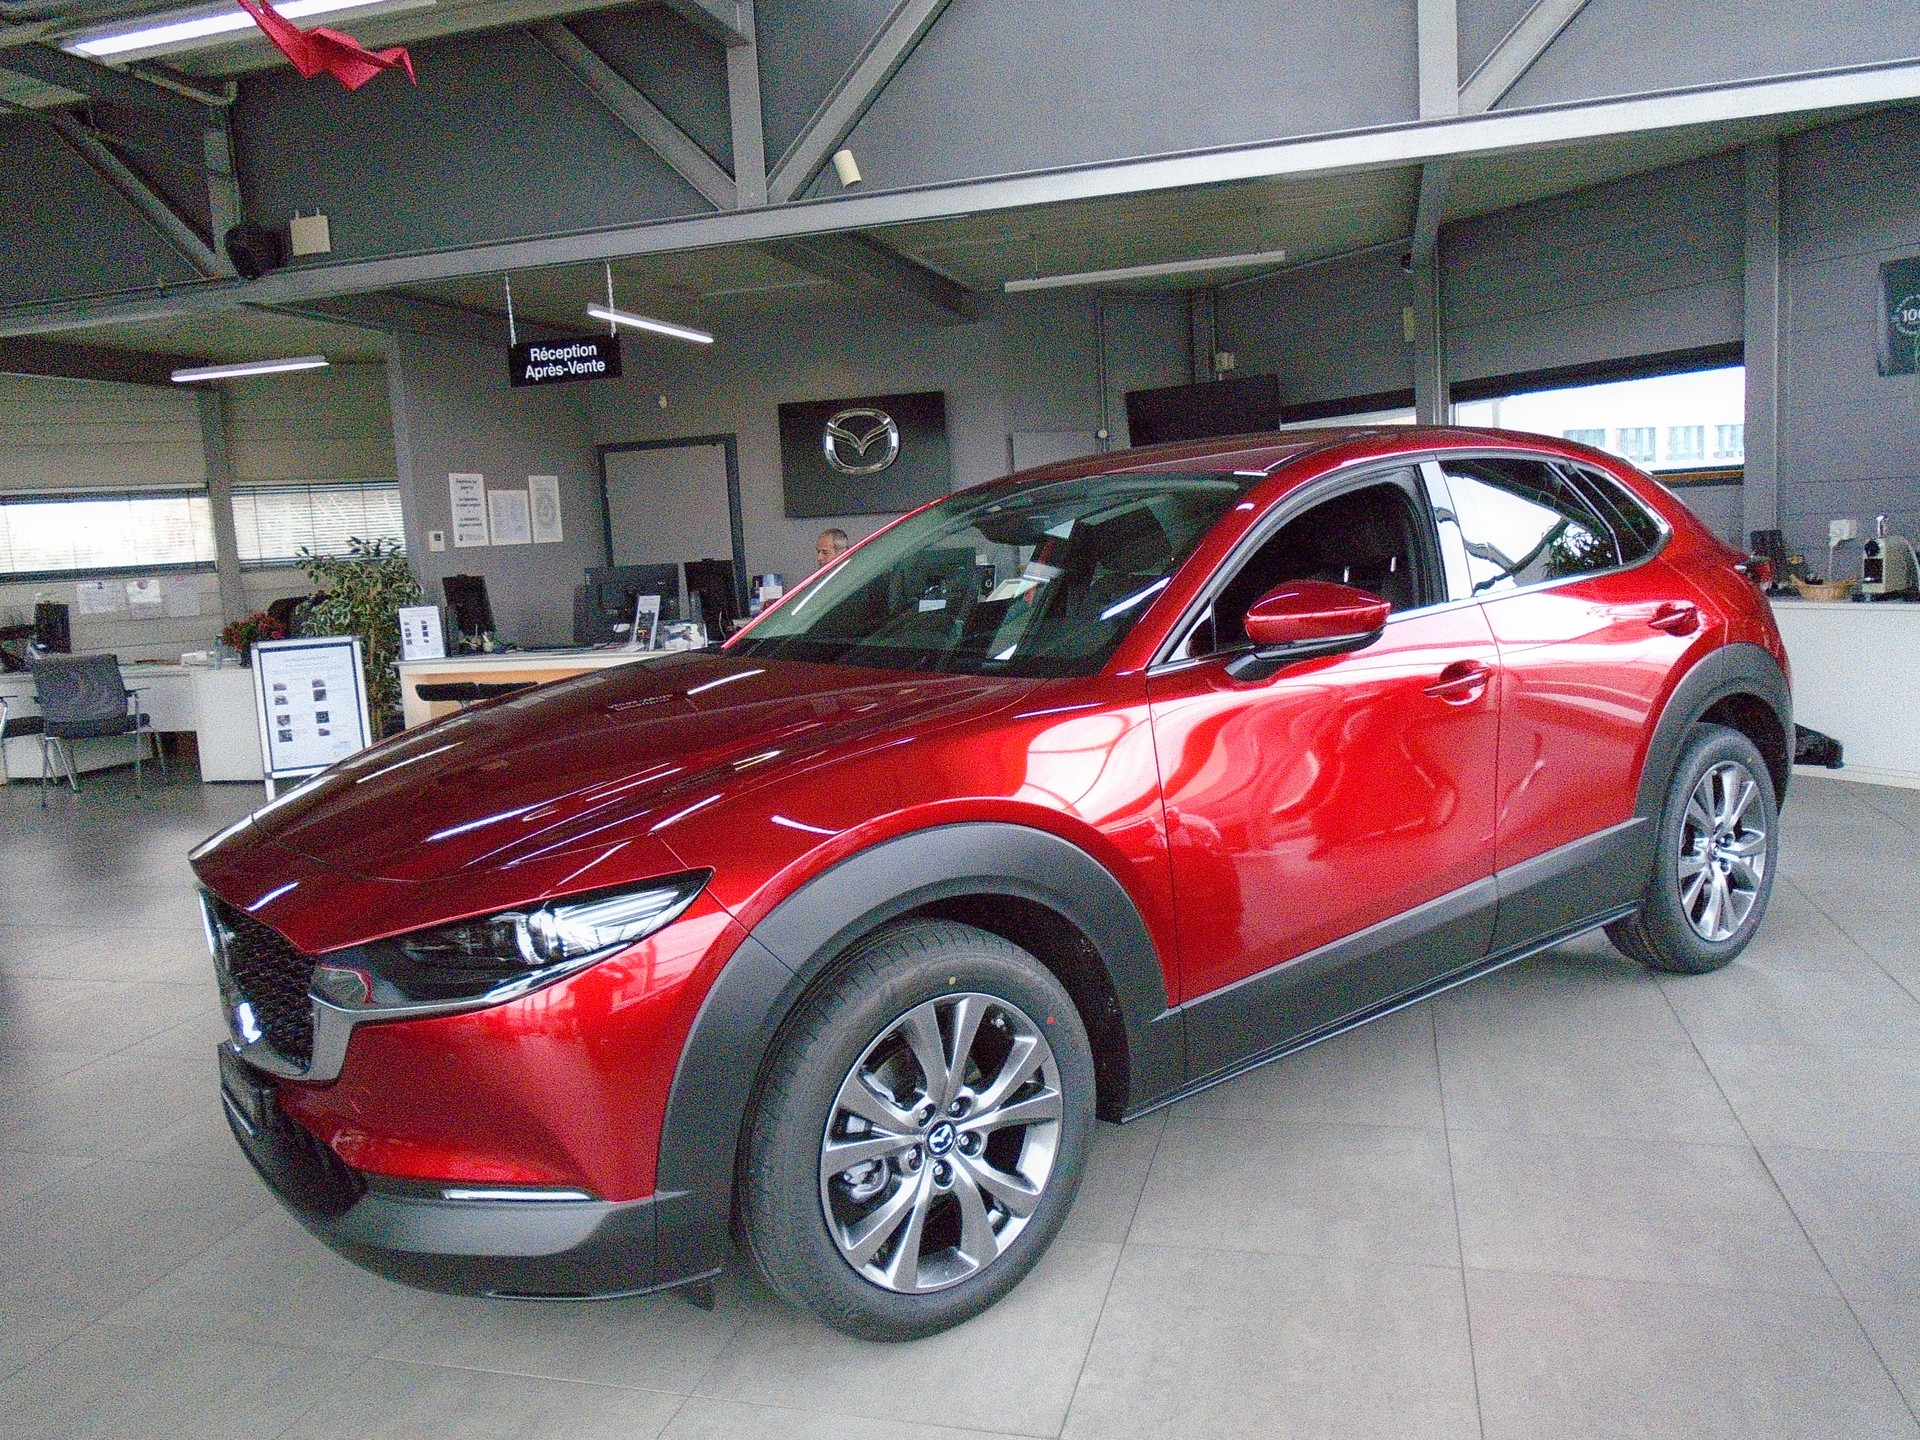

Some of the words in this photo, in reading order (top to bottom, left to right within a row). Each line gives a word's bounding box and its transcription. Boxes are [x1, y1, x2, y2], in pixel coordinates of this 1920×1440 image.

[1901, 308, 1920, 322] 10
[530, 344, 598, 362] Réception
[525, 359, 606, 381] Après-Vente
